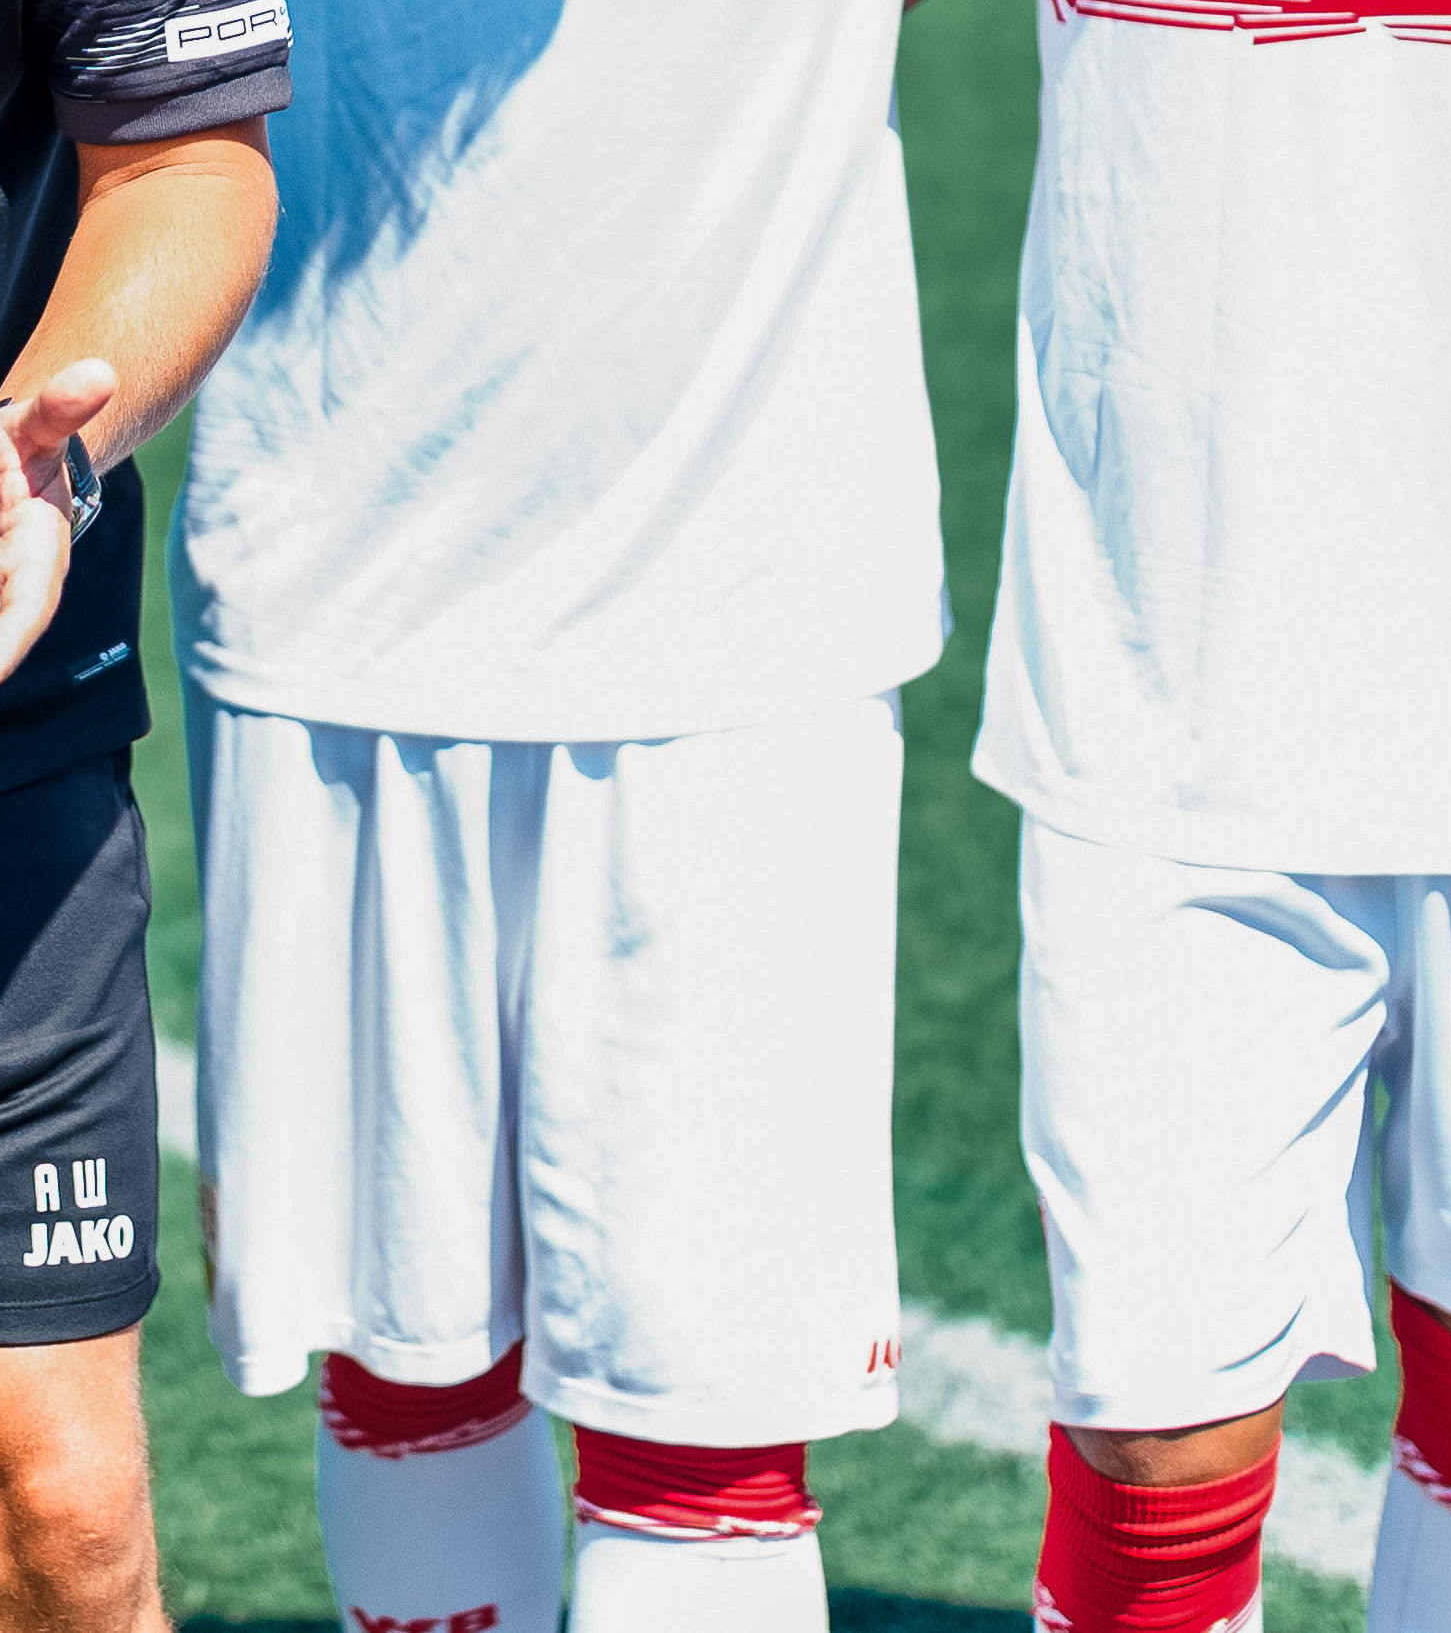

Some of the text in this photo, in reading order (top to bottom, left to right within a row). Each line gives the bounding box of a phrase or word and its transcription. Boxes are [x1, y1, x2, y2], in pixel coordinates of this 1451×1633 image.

[34, 1157, 108, 1212] A W
[23, 1214, 135, 1267] JAKO
